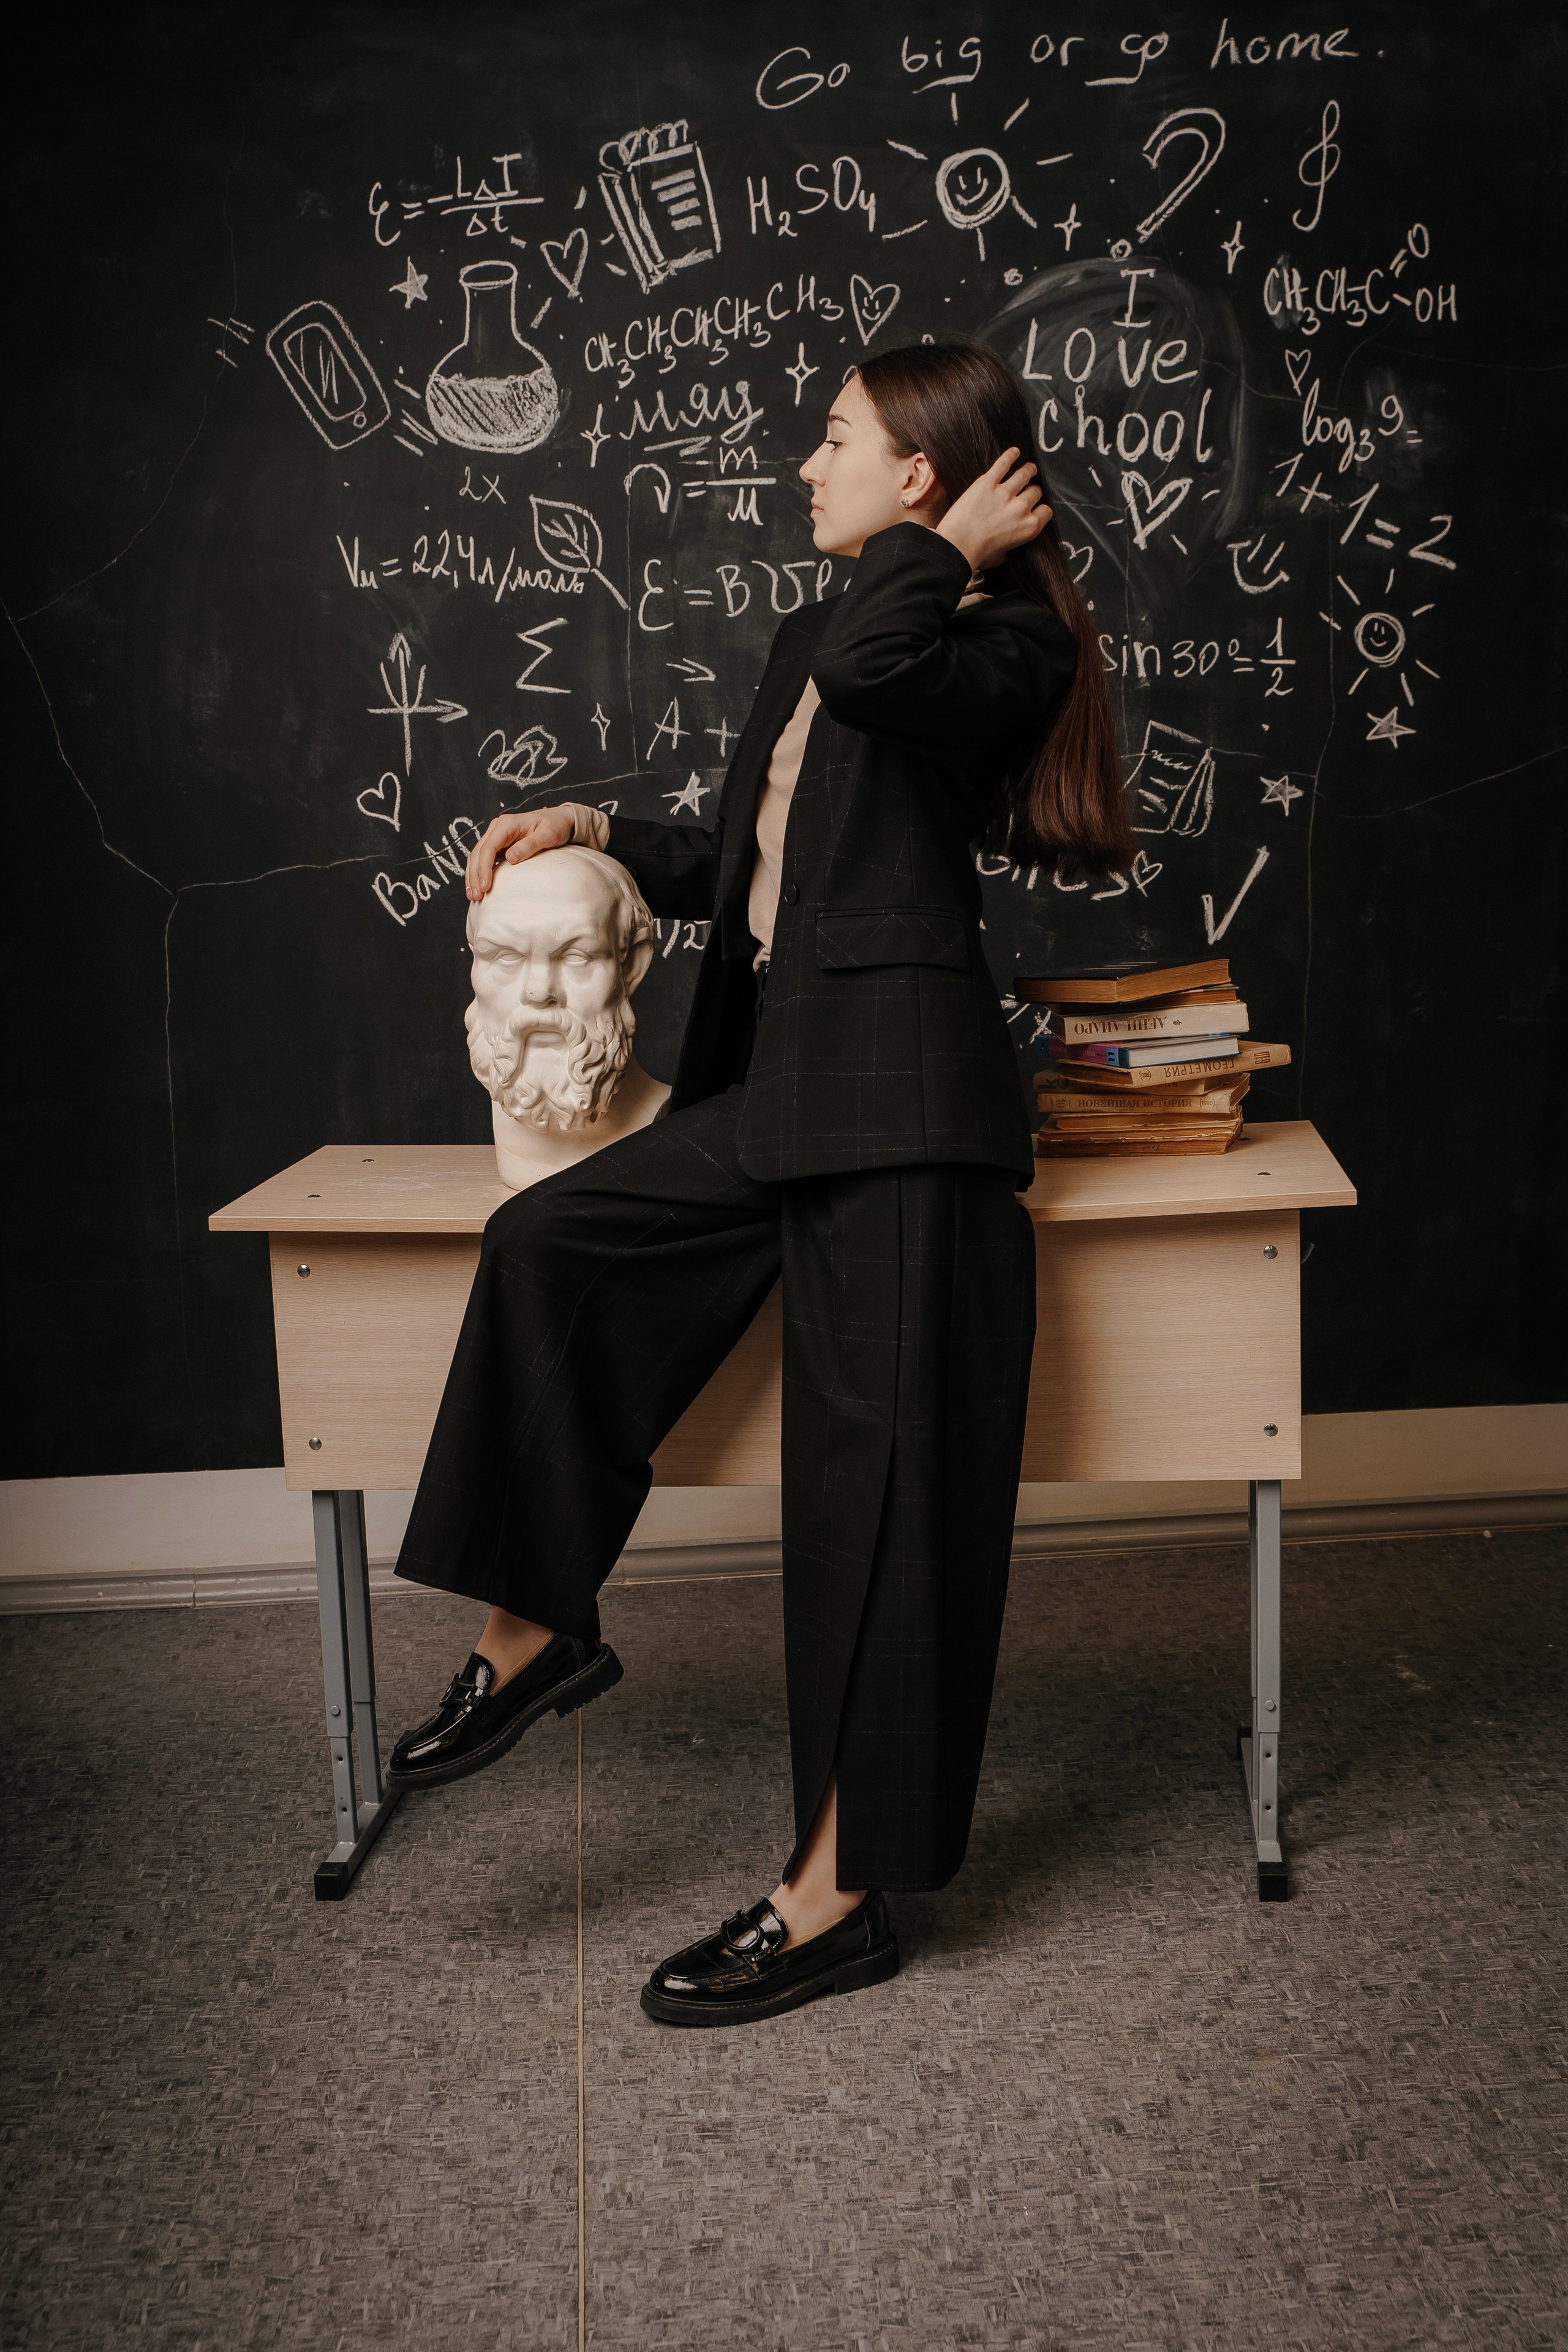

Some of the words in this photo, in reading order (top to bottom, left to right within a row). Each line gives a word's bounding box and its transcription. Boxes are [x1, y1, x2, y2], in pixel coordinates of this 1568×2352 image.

[756, 47, 850, 110] Go
[902, 36, 981, 94] big
[1030, 34, 1084, 66] or
[1085, 31, 1169, 86] go
[1074, 1019, 1121, 1036] ДИДРО
[1126, 1016, 1167, 1033] ДЕНИ
[1163, 1058, 1235, 1078] ГЕОМЕТРИЯ
[1142, 1098, 1193, 1109] ИСТОРИЯ
